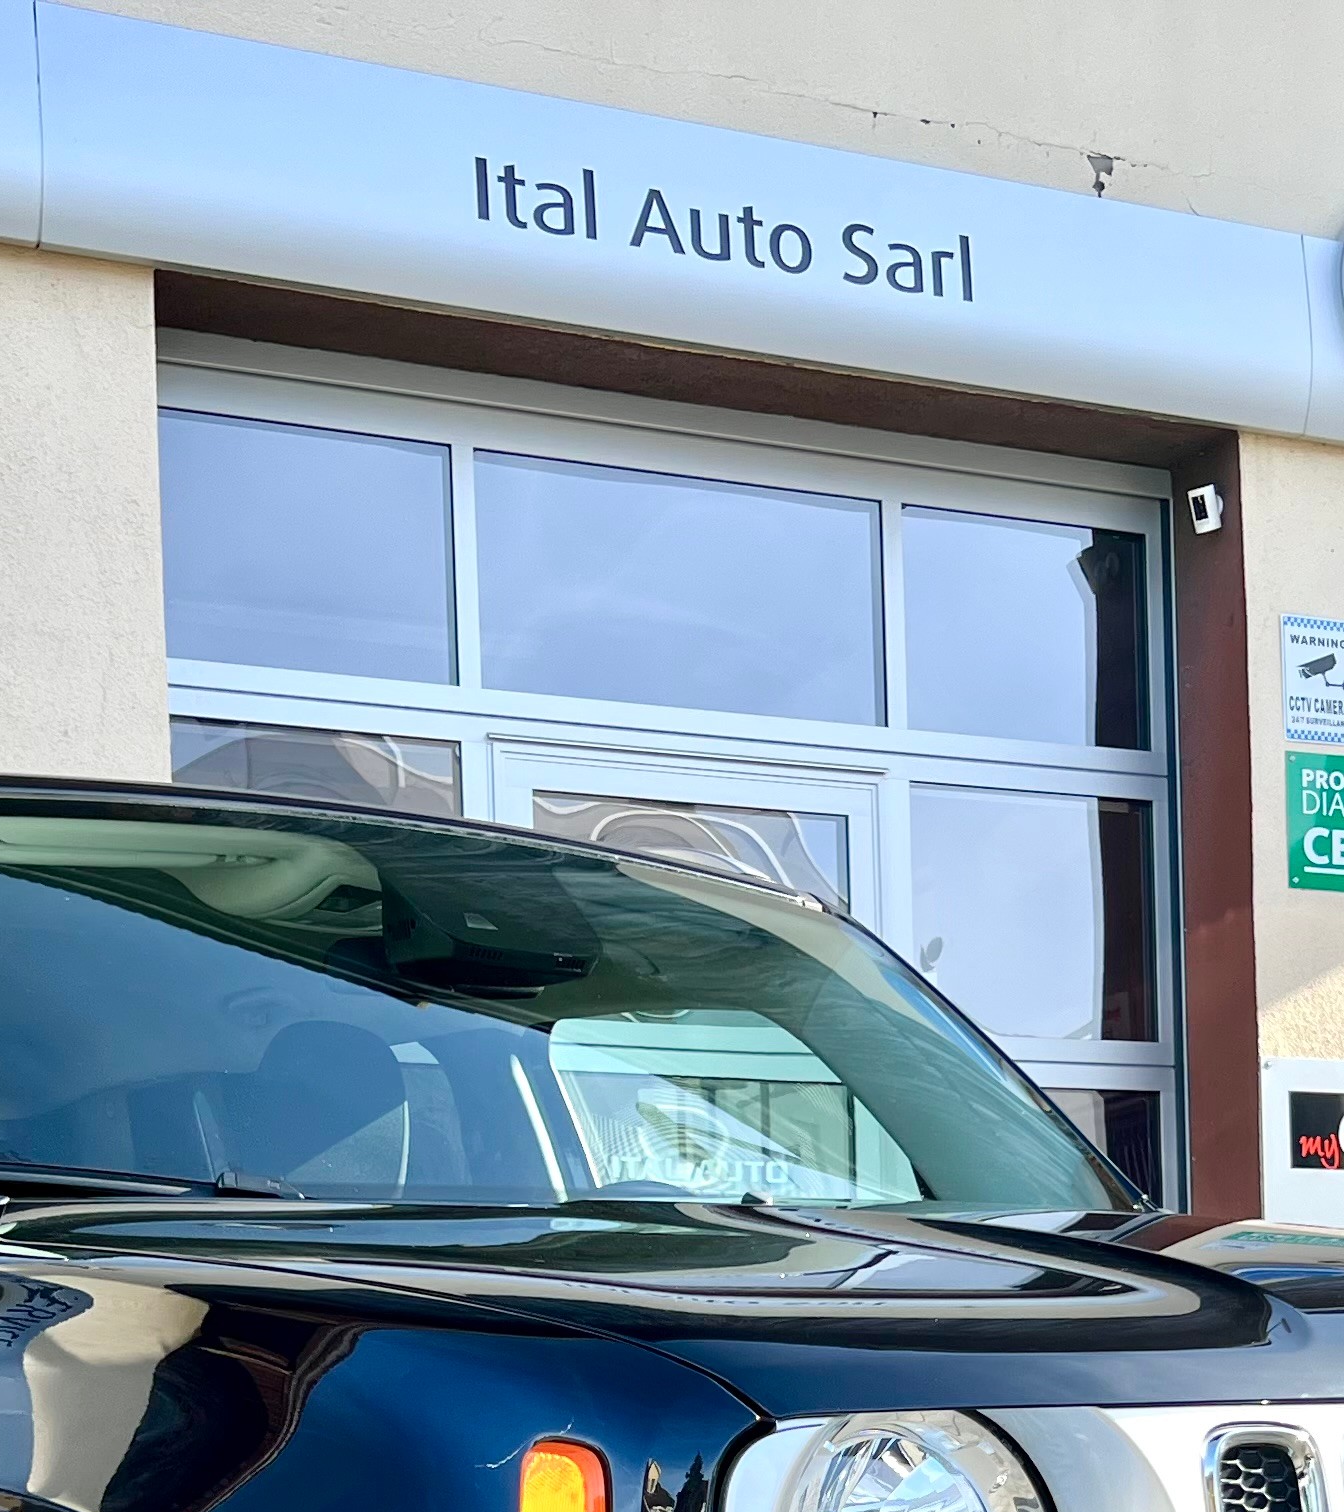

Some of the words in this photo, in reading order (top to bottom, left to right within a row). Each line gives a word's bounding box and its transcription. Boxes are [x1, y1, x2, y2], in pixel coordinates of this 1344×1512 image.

[473, 156, 598, 240] Ital
[629, 188, 813, 275] Auto
[841, 222, 974, 303] Sarl
[1288, 695, 1312, 713] CCTV
